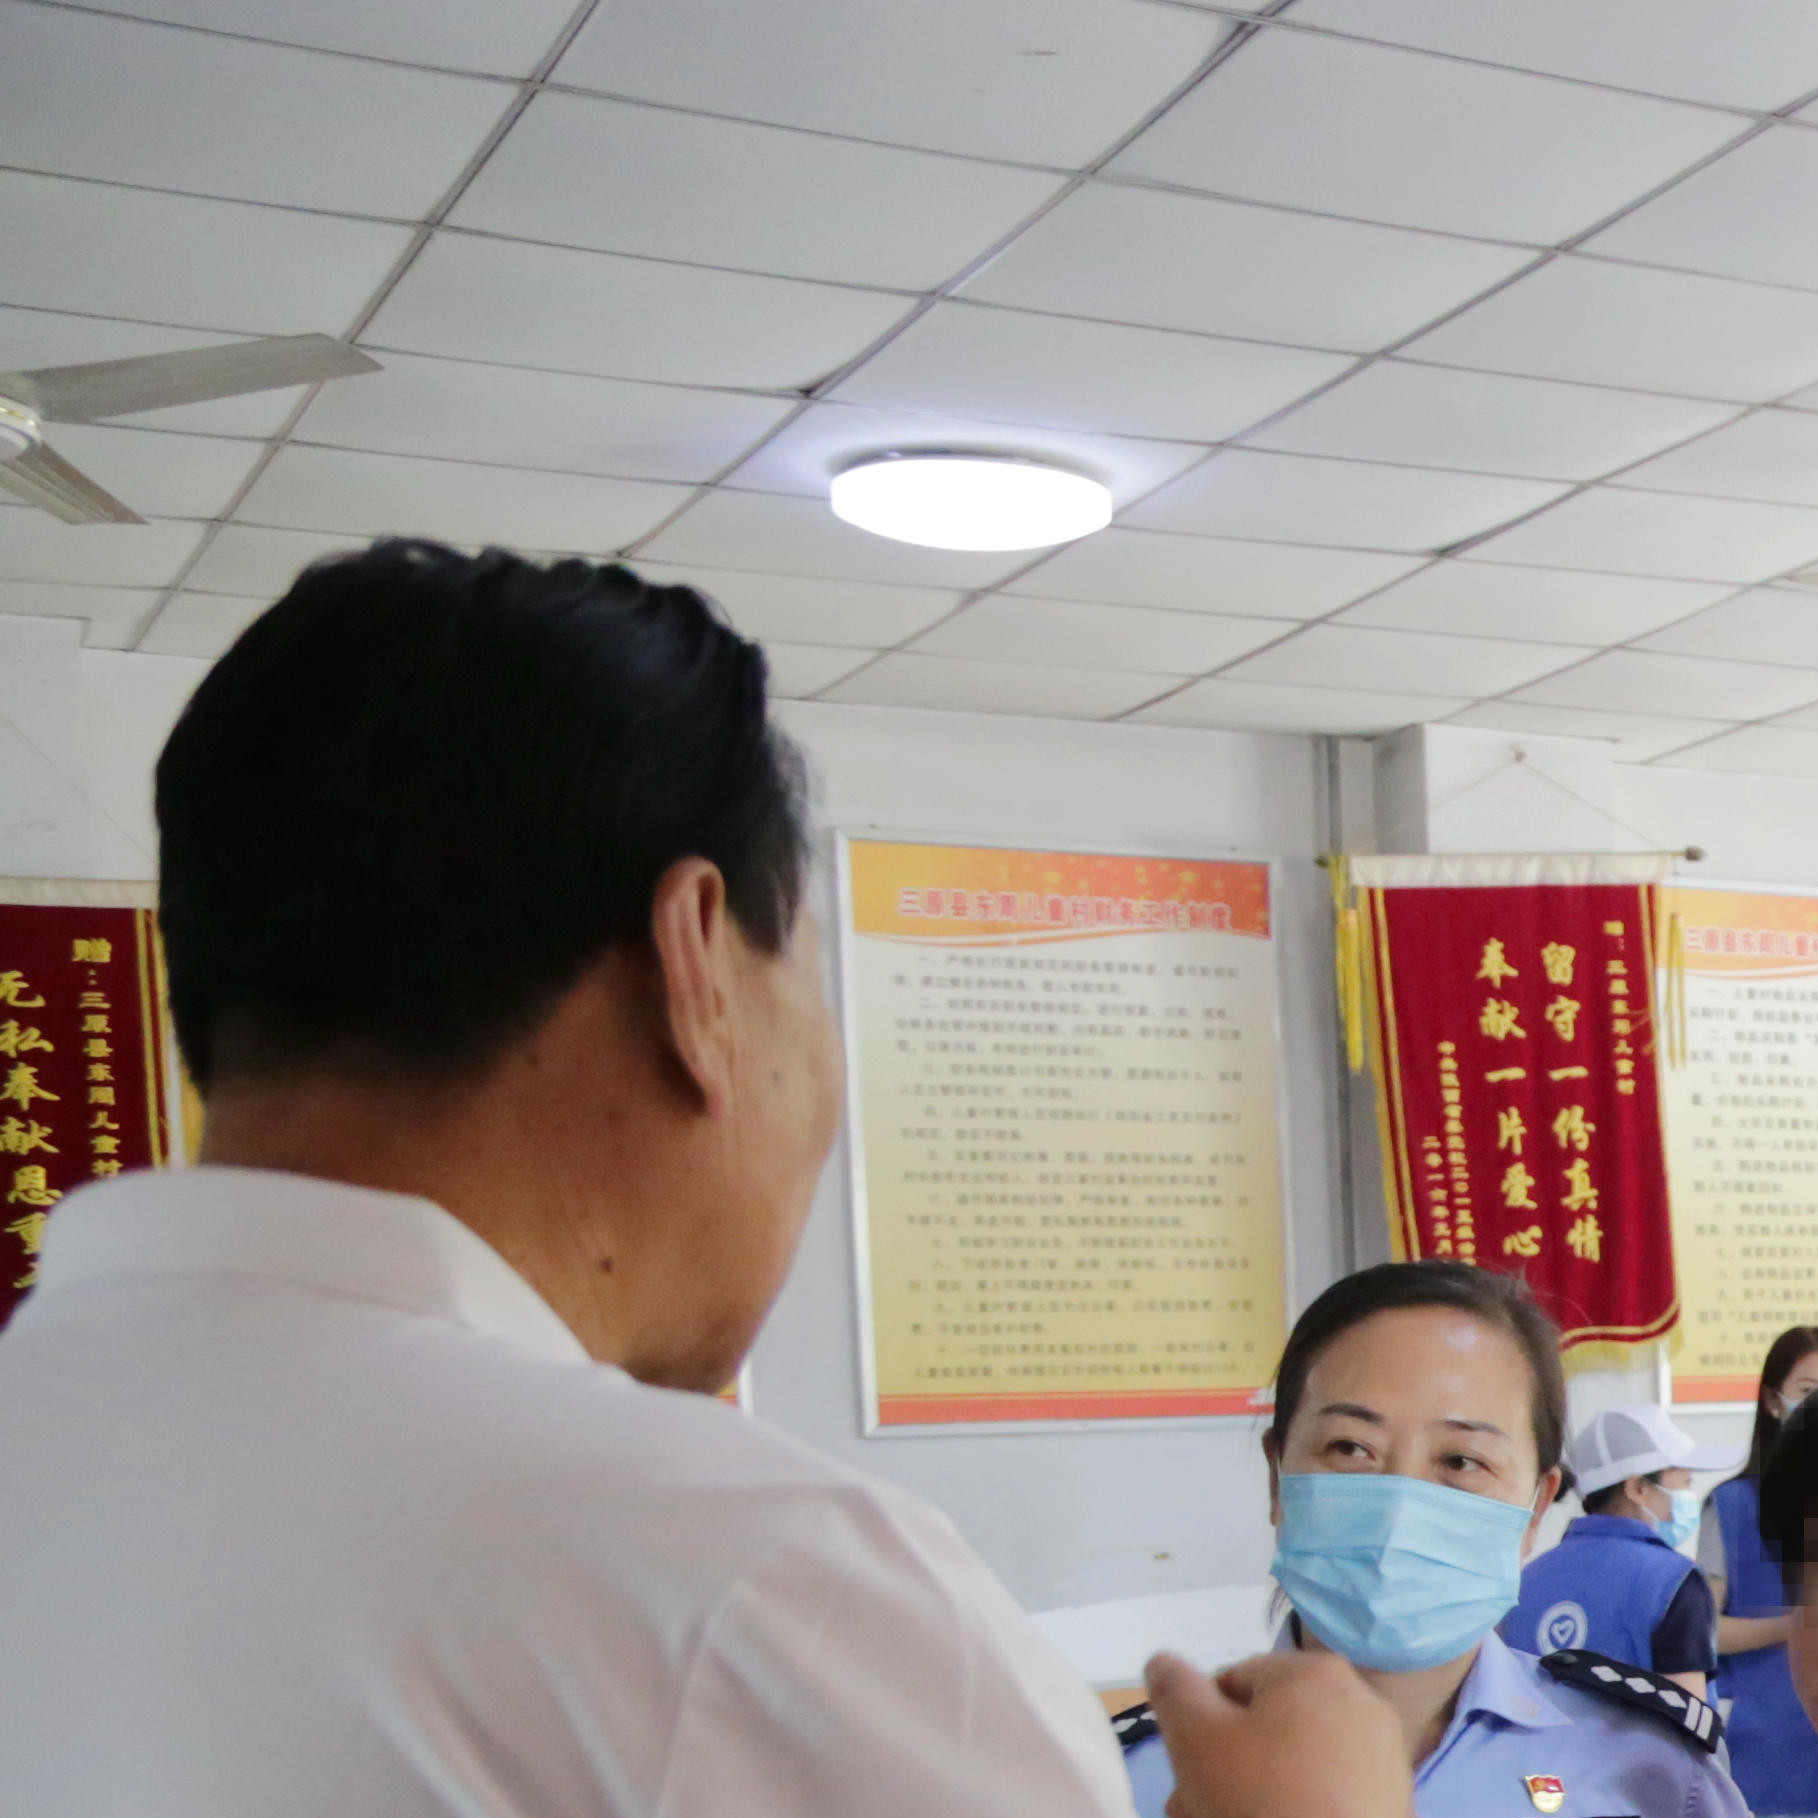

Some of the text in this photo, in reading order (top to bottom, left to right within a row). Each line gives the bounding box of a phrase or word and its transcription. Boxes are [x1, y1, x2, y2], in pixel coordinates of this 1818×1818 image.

[1475, 936, 1544, 1257] 奉献一片爱心
[1541, 940, 1604, 1263] 留守一份真情
